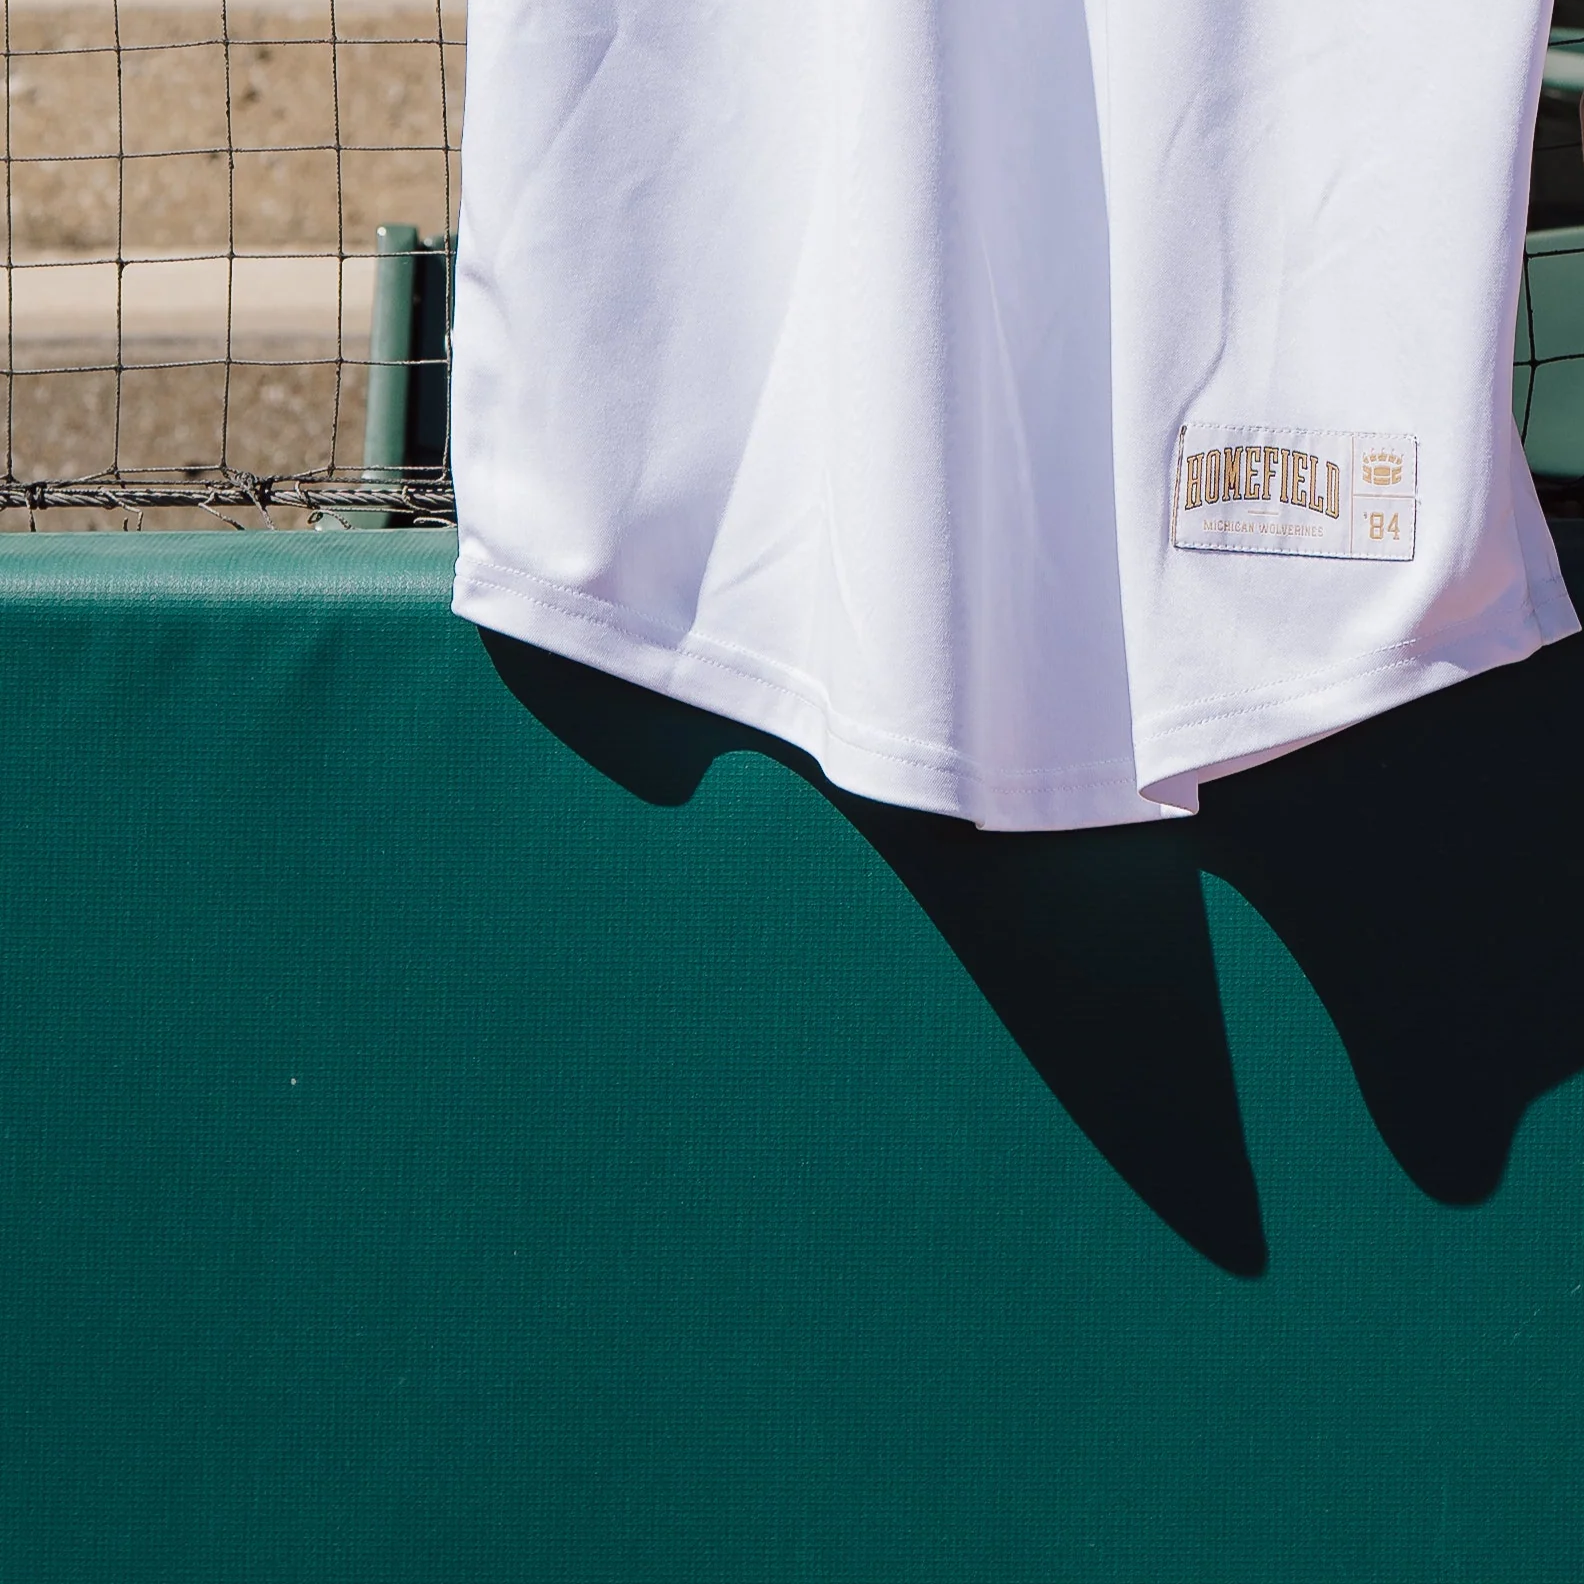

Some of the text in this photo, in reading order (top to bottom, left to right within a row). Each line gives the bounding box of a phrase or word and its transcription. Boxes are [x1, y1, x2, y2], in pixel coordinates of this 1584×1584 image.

[1184, 446, 1341, 519] HOMEFIELD
[1203, 519, 1324, 538] MICHIGAN WOLVERINES
